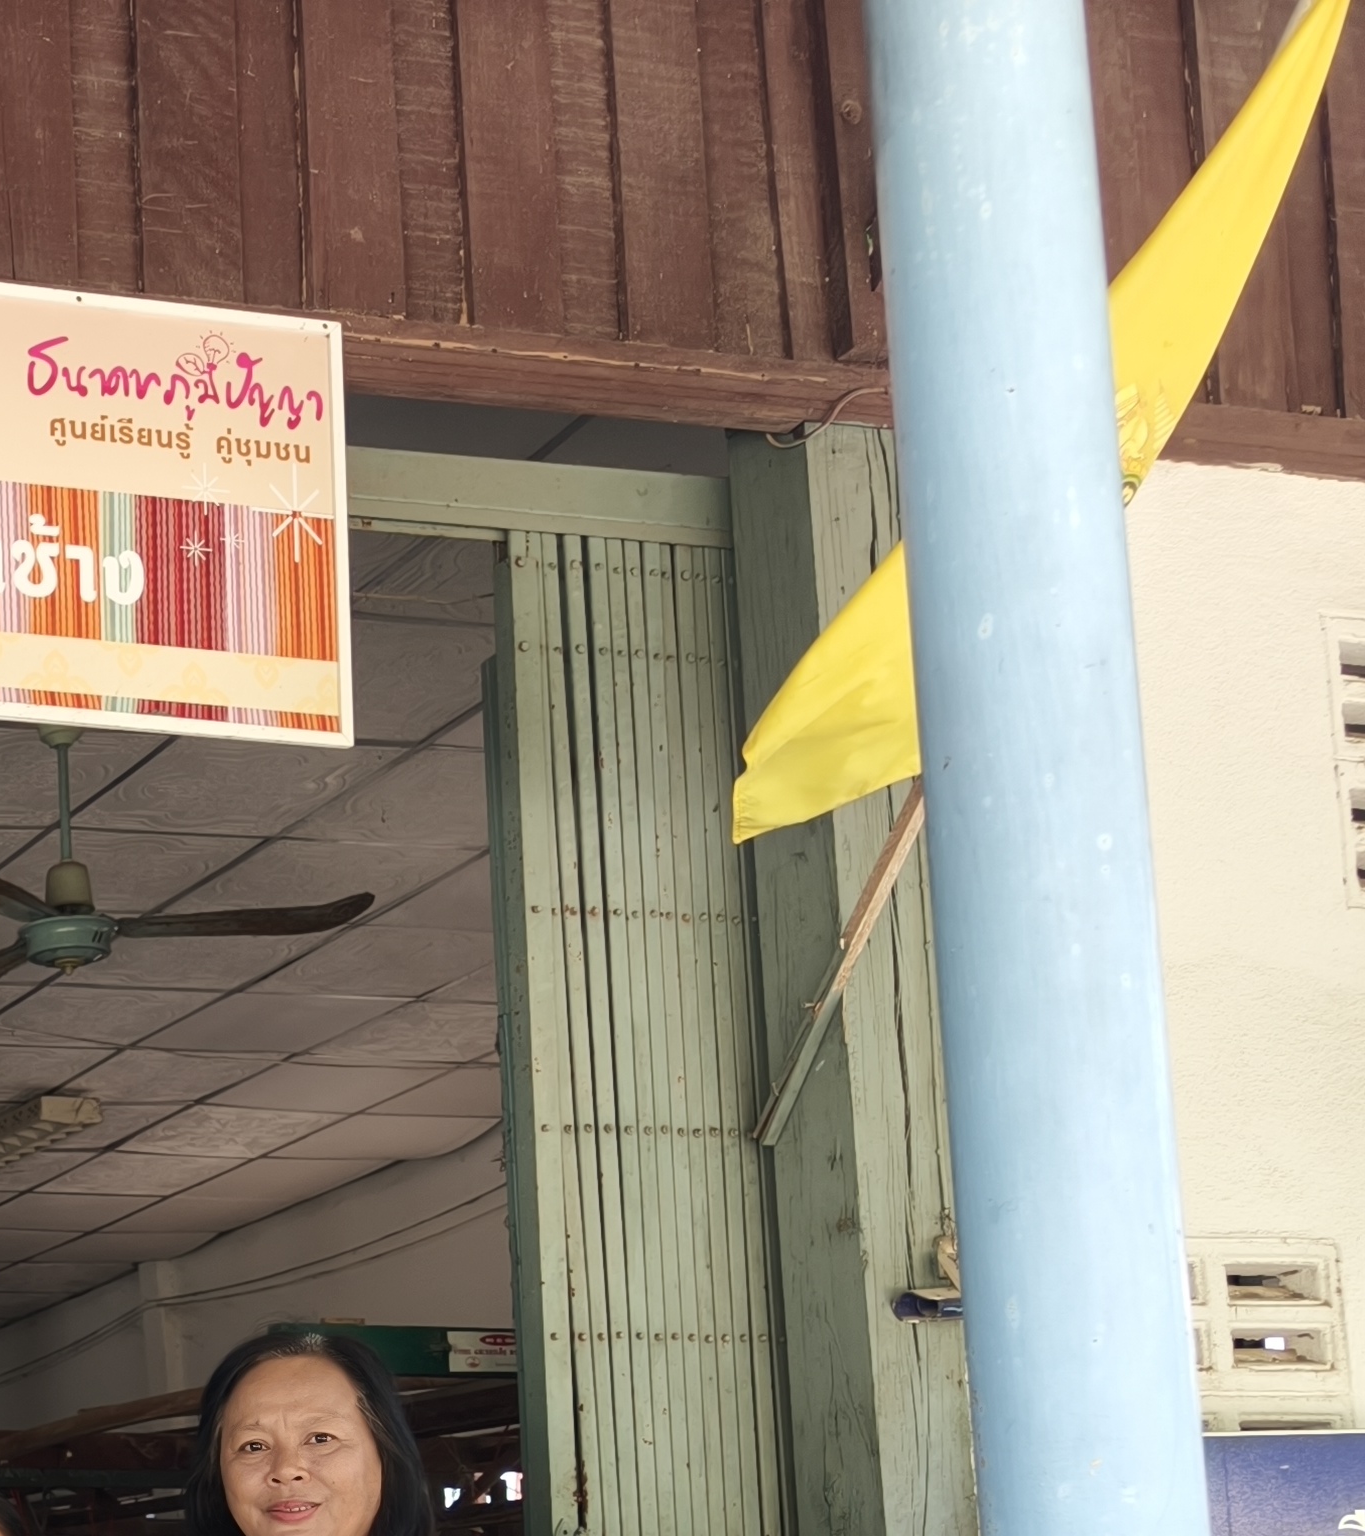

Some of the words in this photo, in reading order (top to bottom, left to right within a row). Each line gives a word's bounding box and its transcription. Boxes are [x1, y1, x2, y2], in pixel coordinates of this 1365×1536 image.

[49, 415, 194, 460] ศูนย์เรียนรู้
[216, 428, 311, 467] คู่ชุมชน
